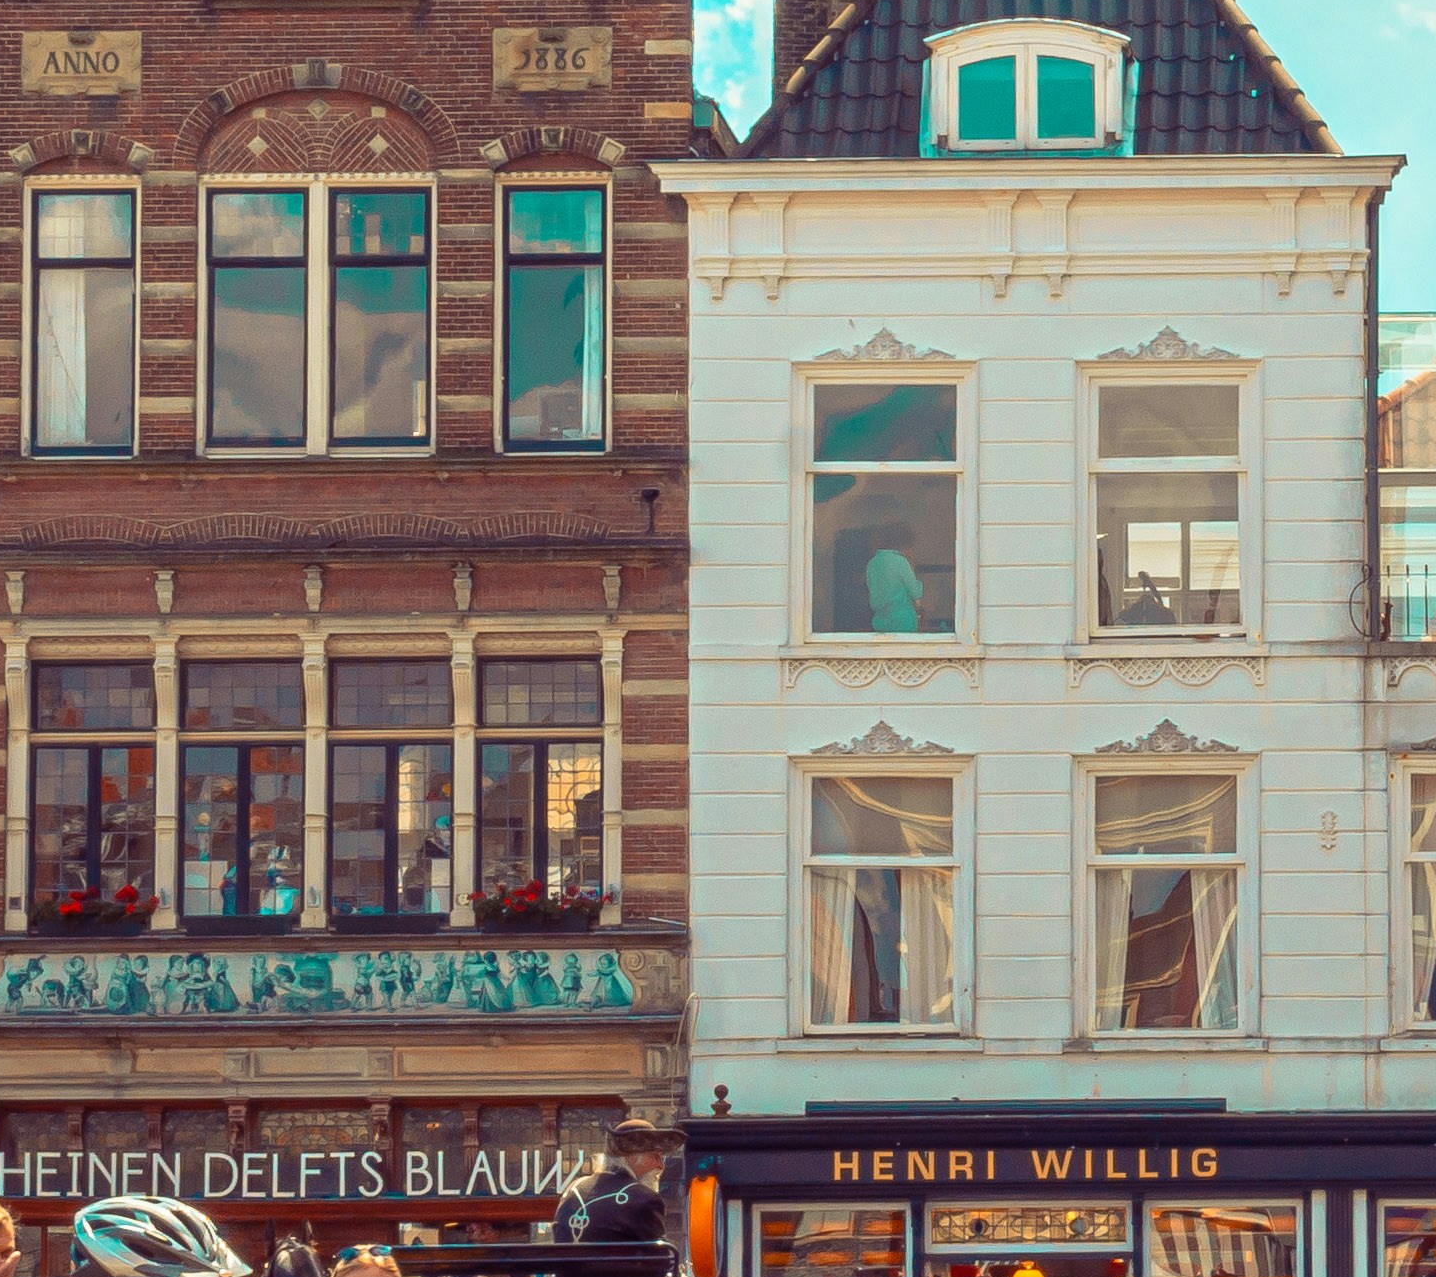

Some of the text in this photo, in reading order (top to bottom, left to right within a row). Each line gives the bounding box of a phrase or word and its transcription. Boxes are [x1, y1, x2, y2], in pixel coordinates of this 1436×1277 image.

[43, 51, 120, 74] ANNO
[514, 47, 591, 70] 1886
[203, 1151, 384, 1198] DELFTS
[406, 1150, 585, 1196] BLAUW
[833, 1148, 1218, 1180] HENRI WILLIG
